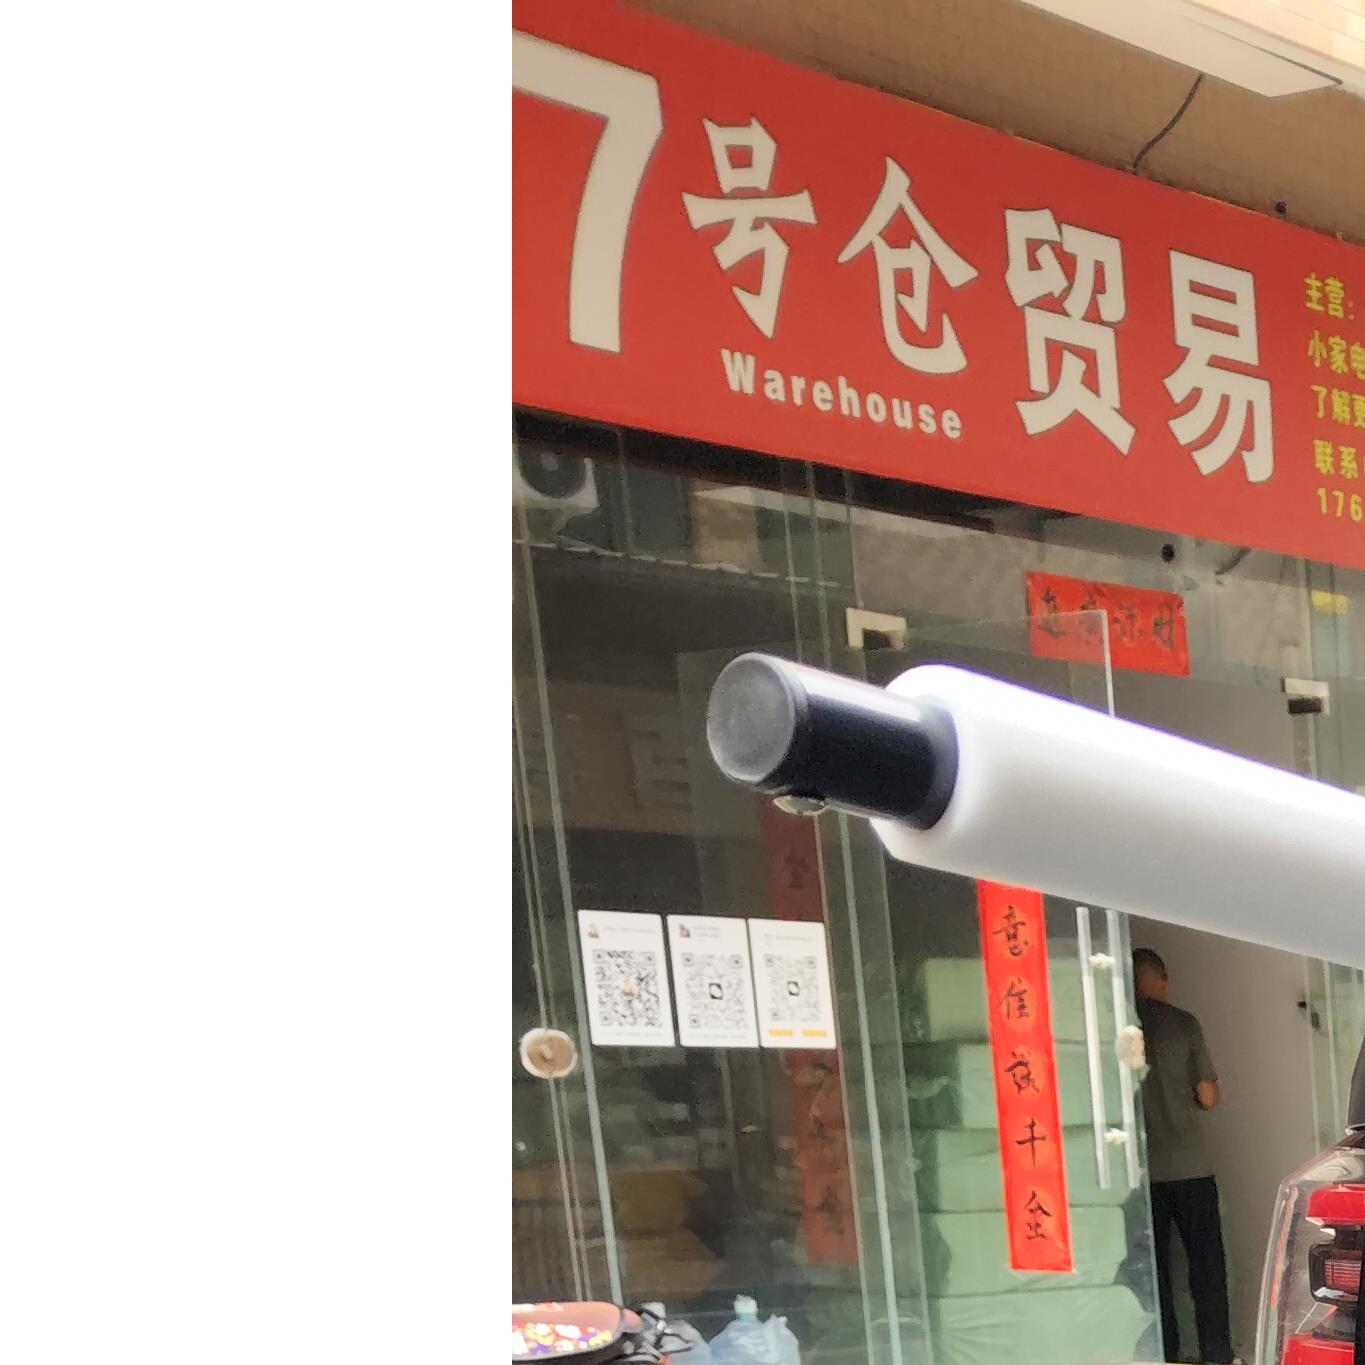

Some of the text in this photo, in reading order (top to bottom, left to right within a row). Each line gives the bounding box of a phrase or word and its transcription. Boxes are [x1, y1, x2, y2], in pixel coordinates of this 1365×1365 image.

[512, 30, 1274, 484] 7号仓贸易
[722, 348, 962, 440] Warehouse
